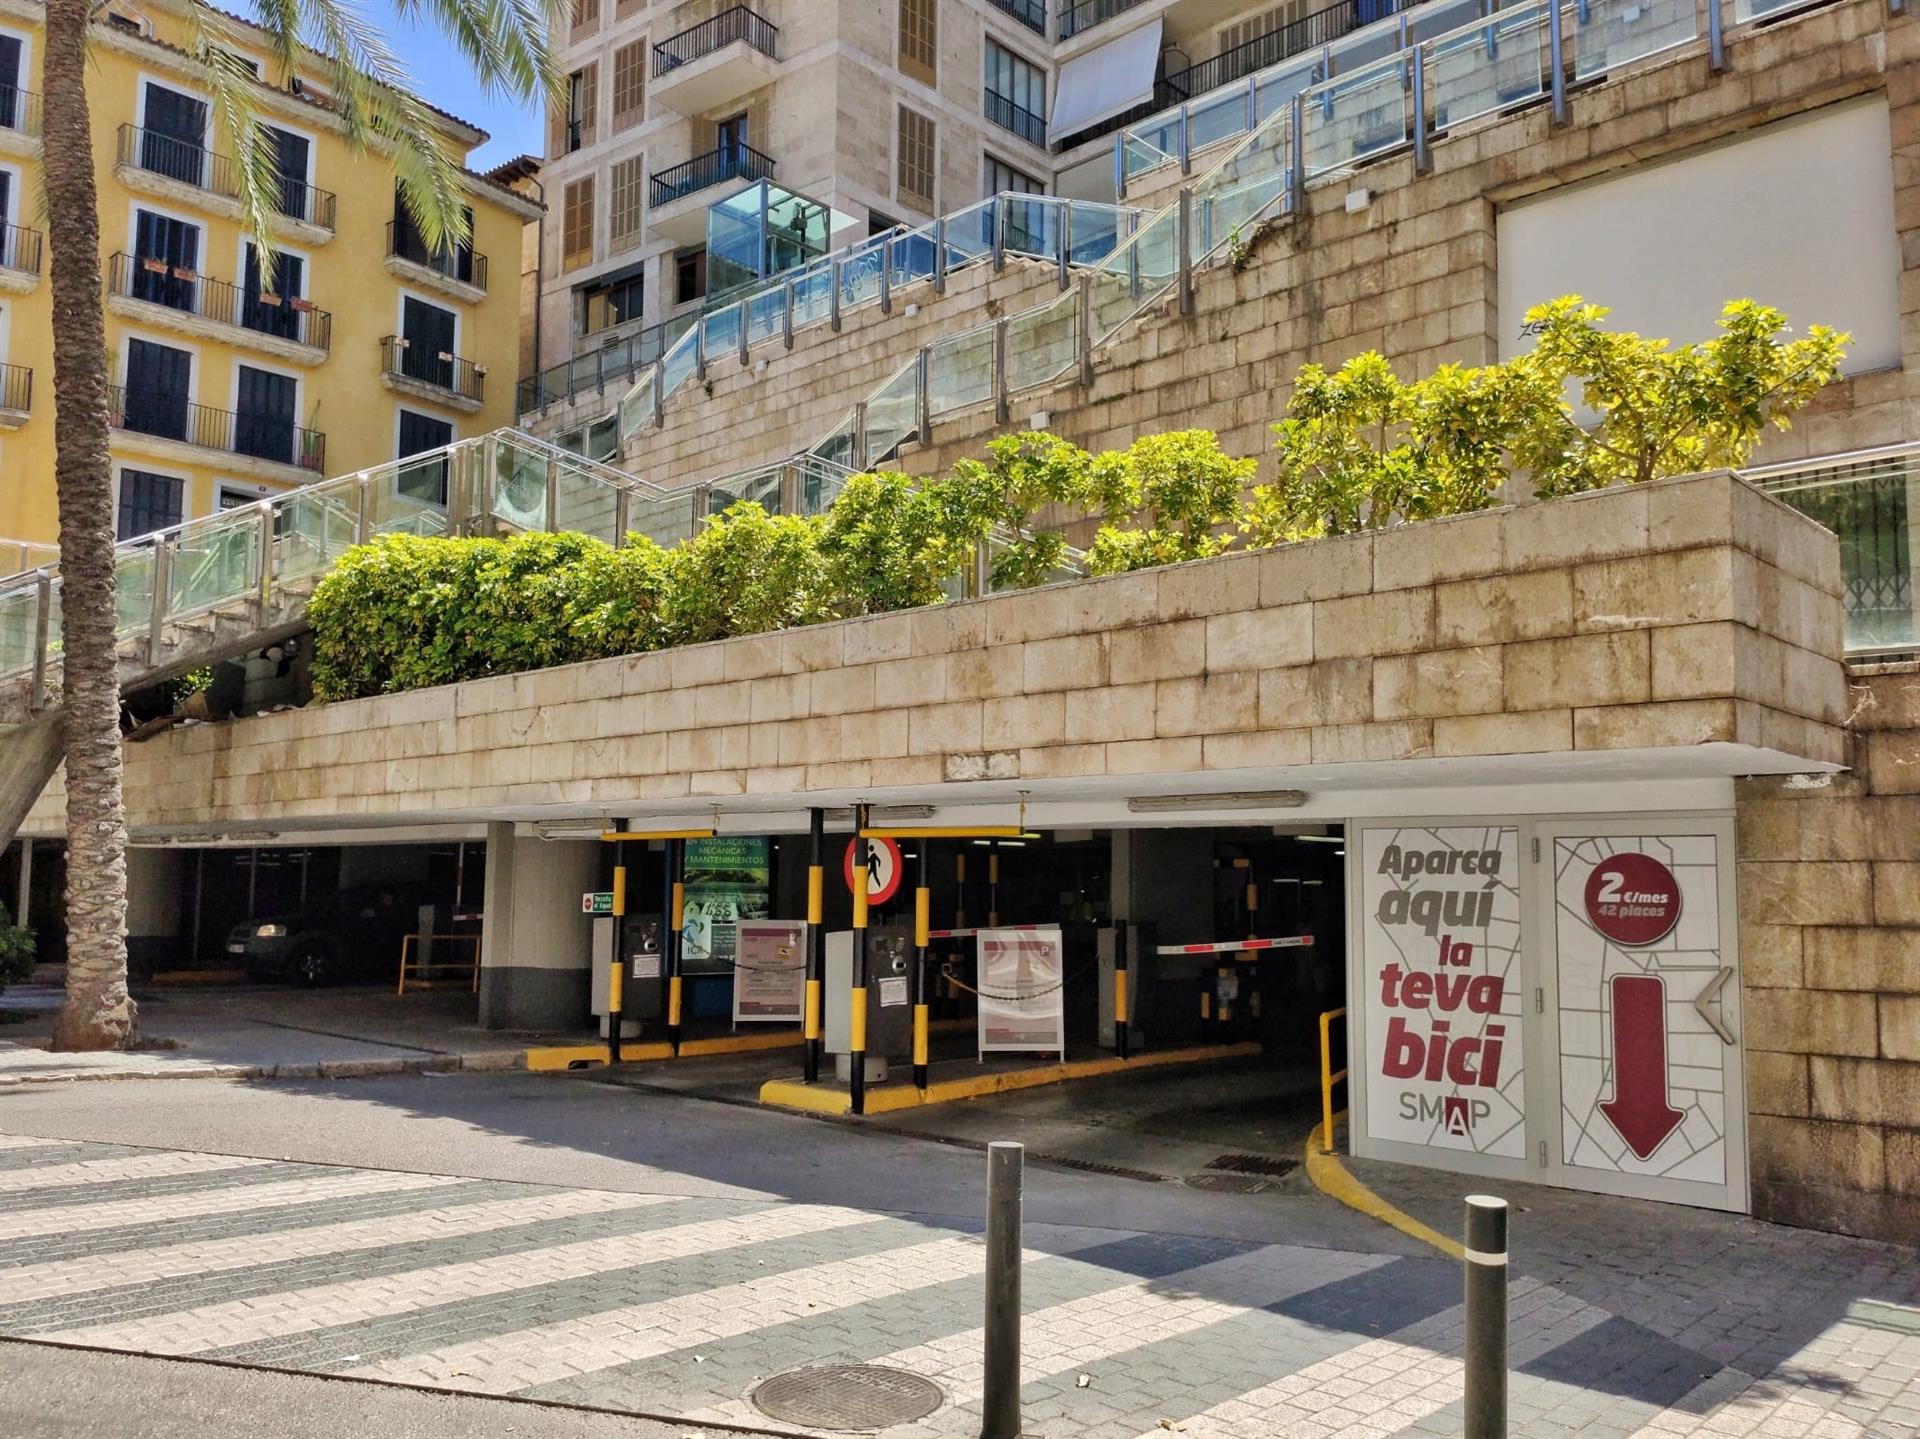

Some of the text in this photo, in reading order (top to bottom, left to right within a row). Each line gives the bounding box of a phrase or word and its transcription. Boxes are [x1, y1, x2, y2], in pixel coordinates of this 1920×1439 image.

[690, 856, 765, 865] MANTENIMIENTOS
[1377, 845, 1502, 881] Aparca
[1378, 880, 1502, 937] aquí
[1599, 904, 1666, 919] 42 places
[1438, 934, 1474, 968] la
[1379, 963, 1505, 1015] teva
[1382, 1016, 1506, 1089] bici
[1399, 1091, 1492, 1137] SMAP
